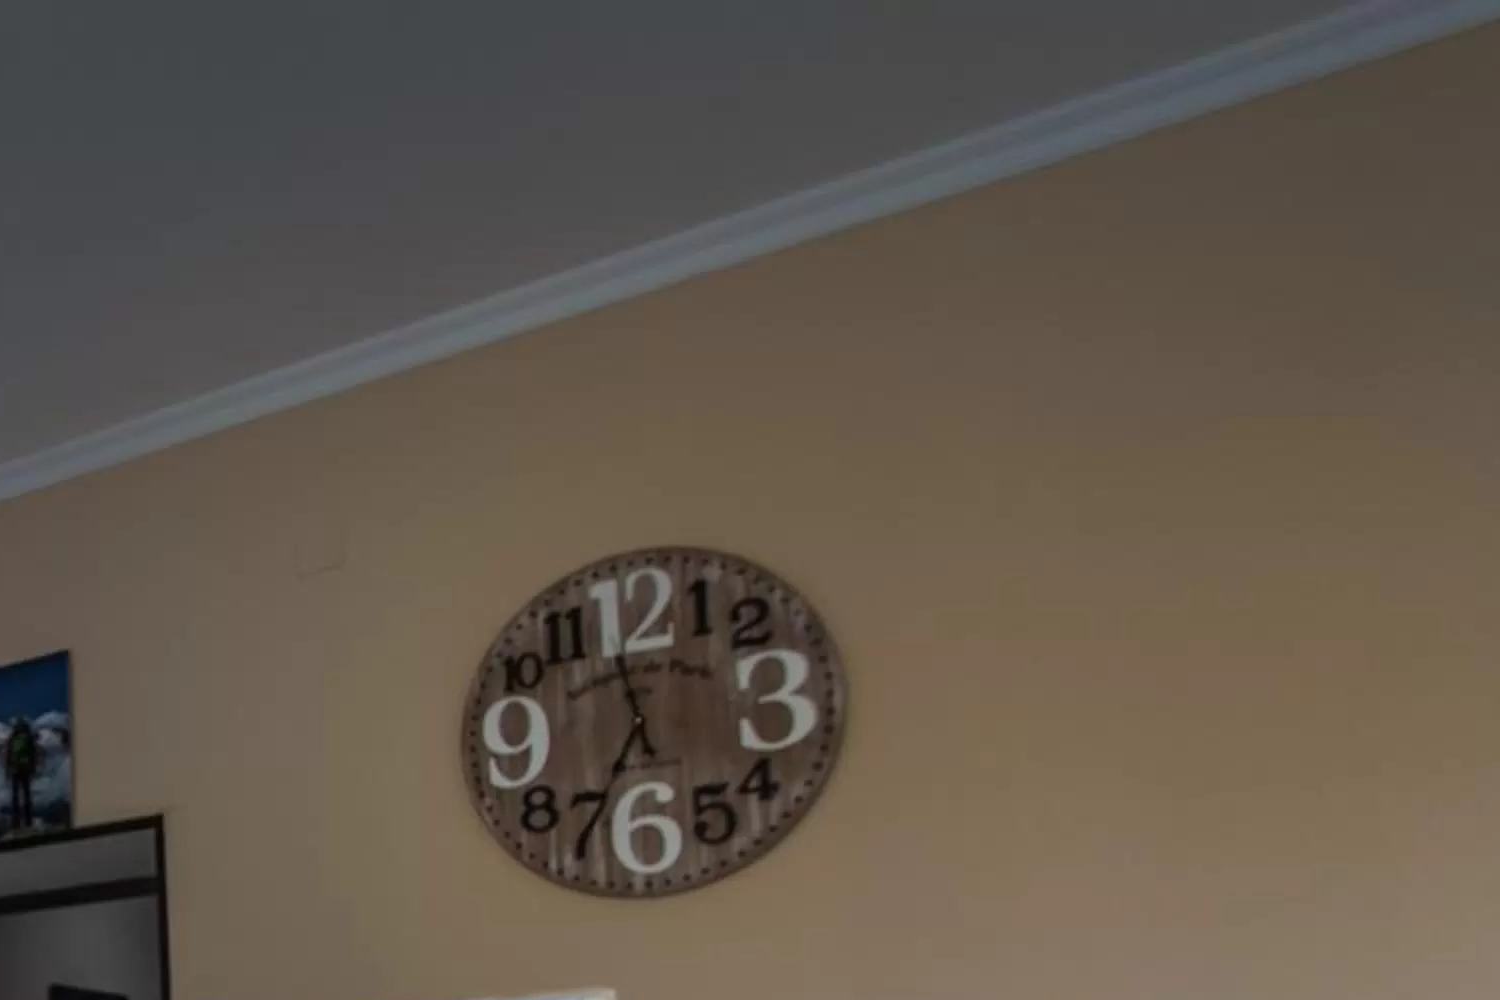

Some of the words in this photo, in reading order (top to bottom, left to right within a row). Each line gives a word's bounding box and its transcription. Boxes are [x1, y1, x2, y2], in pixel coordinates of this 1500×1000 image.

[545, 607, 586, 666] 11
[589, 566, 675, 658] 12
[687, 579, 713, 637] 1
[729, 597, 773, 649] 2
[502, 652, 544, 693] 10
[735, 648, 818, 752] 3
[482, 695, 551, 789] 9
[520, 786, 559, 833] 8
[737, 758, 780, 801] 4
[570, 790, 607, 861] 7
[611, 781, 682, 874] 6
[693, 782, 736, 845] 5
